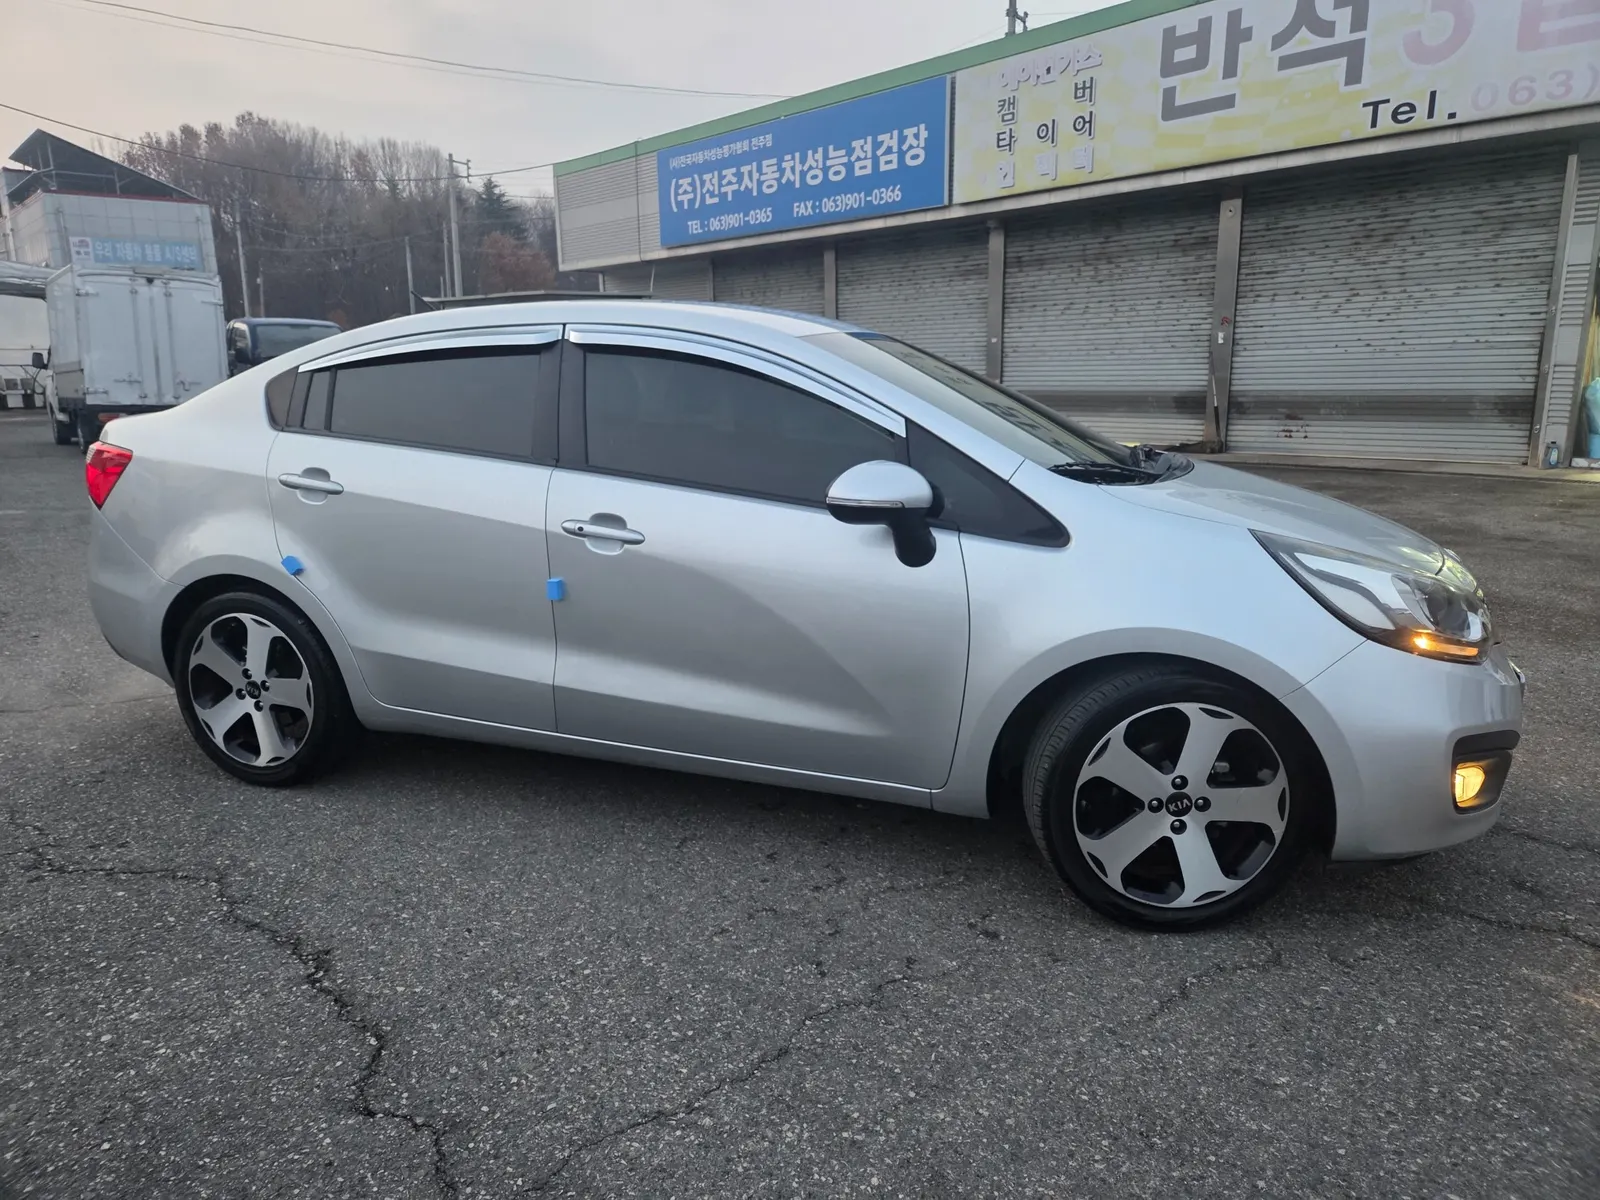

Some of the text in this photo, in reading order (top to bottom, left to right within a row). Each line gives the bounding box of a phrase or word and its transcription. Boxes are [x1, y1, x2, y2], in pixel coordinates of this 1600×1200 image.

[1160, 0, 1370, 121] 반석
[1362, 90, 1457, 129] Tel.
[670, 123, 929, 212] (주)전주자동차성능점검장
[709, 207, 773, 232] 063)901-0365
[821, 184, 902, 214] 063)901-0366
[1168, 798, 1191, 812] KIA
